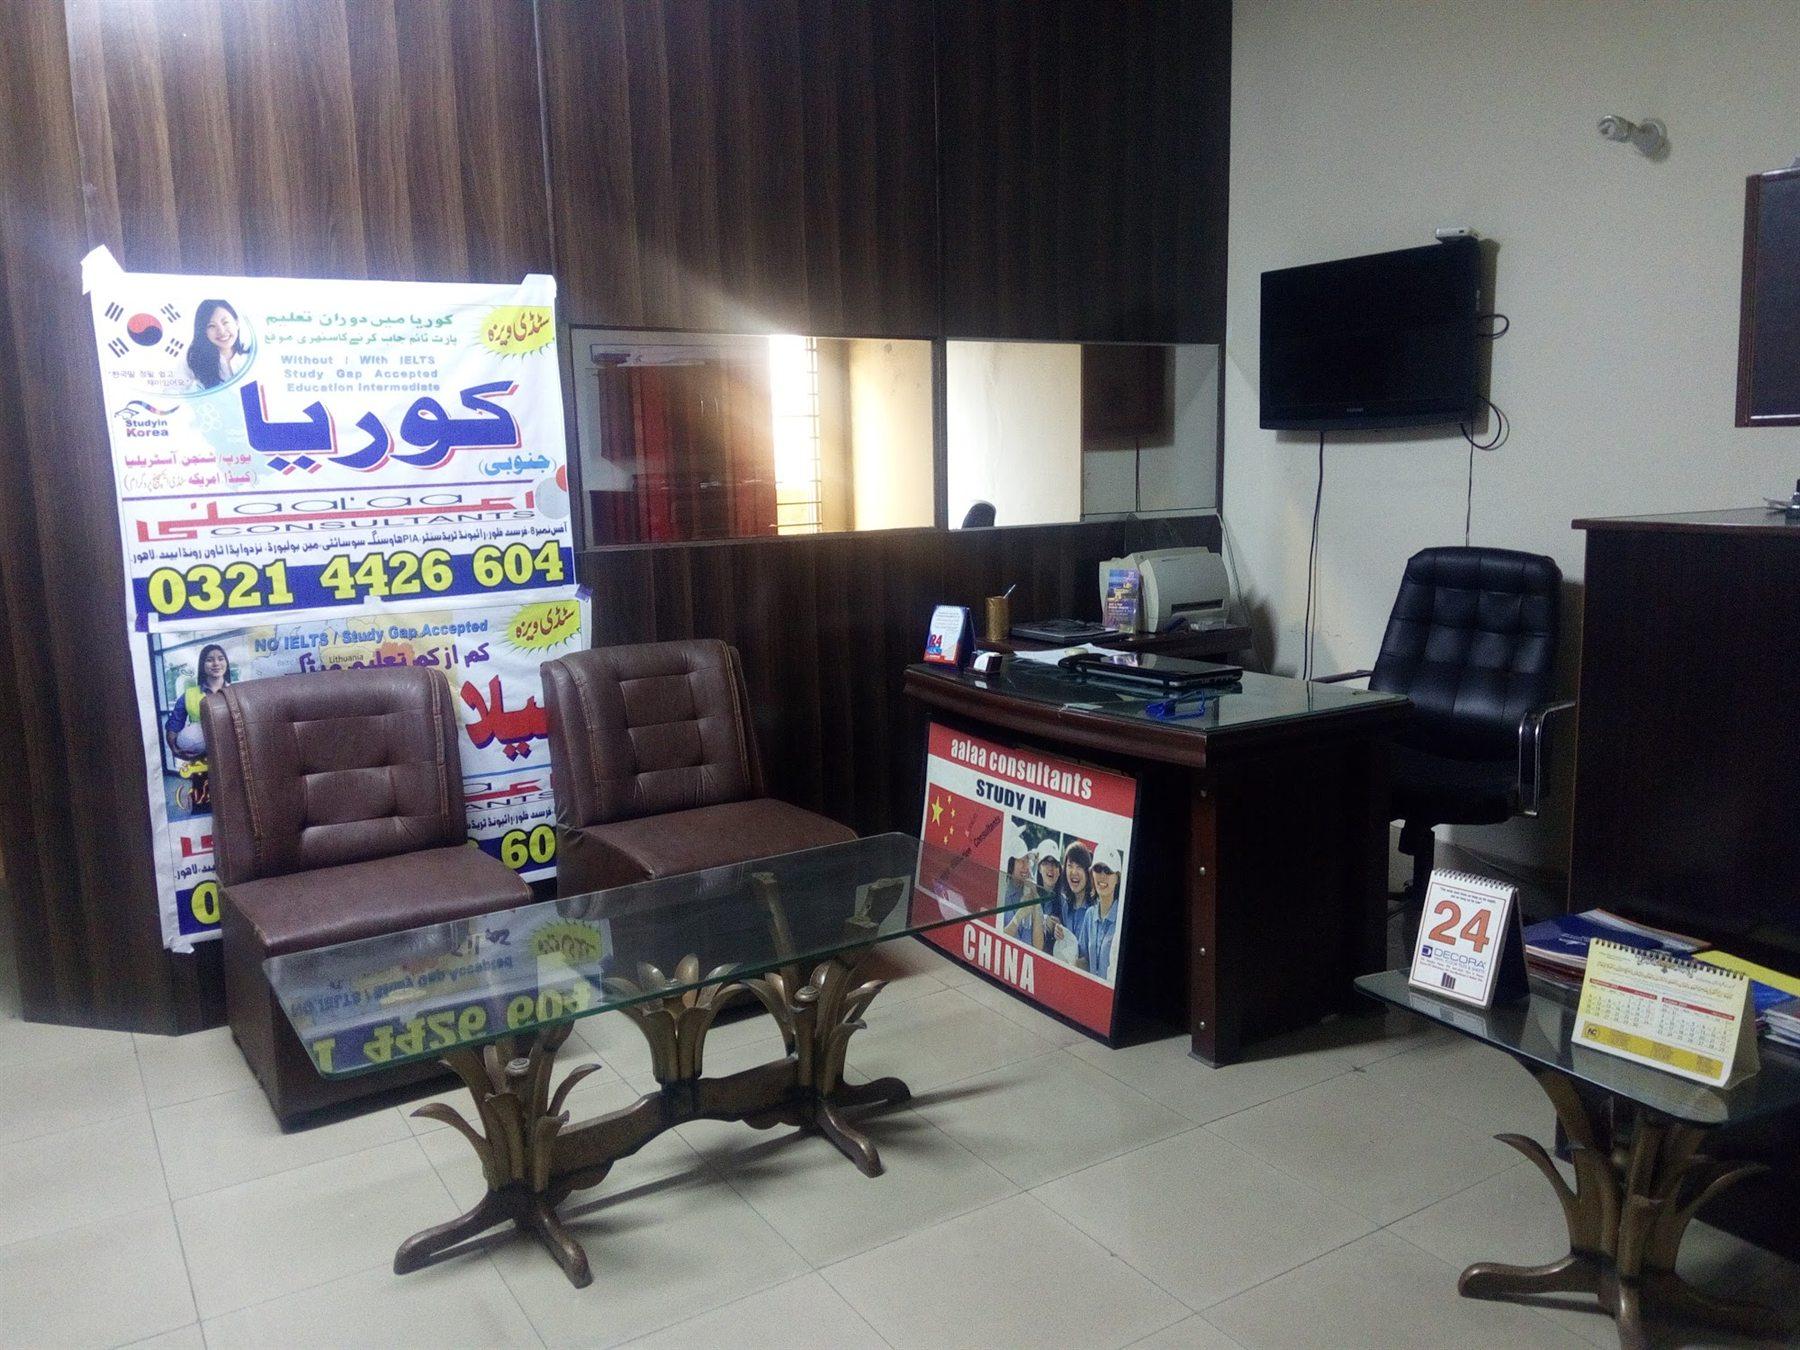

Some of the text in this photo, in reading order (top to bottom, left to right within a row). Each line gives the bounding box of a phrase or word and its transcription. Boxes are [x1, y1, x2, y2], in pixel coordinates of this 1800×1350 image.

[280, 354, 334, 365] Without
[359, 354, 388, 365] With
[399, 354, 436, 365] IELTS
[283, 368, 438, 381] Study Gap Accepted
[286, 382, 441, 393] Education Intermediate
[126, 428, 169, 437] Korea
[240, 379, 520, 475] کوریا
[210, 510, 536, 537] CONSULTANTS
[402, 533, 419, 544] PIA
[148, 540, 564, 615] 0321 4426 604
[254, 637, 280, 652] NO
[284, 631, 329, 651] IELTS
[342, 627, 384, 645] Study
[388, 625, 417, 641] Gap
[421, 618, 489, 638] Accepted
[328, 653, 364, 664] Lithuania
[950, 737, 1093, 801] aalaa consultants
[975, 778, 1048, 819] STUDY IN
[501, 823, 557, 871] 60
[1428, 900, 1492, 953] 24
[962, 923, 1036, 995] CHINA
[1433, 948, 1487, 970] DECORA
